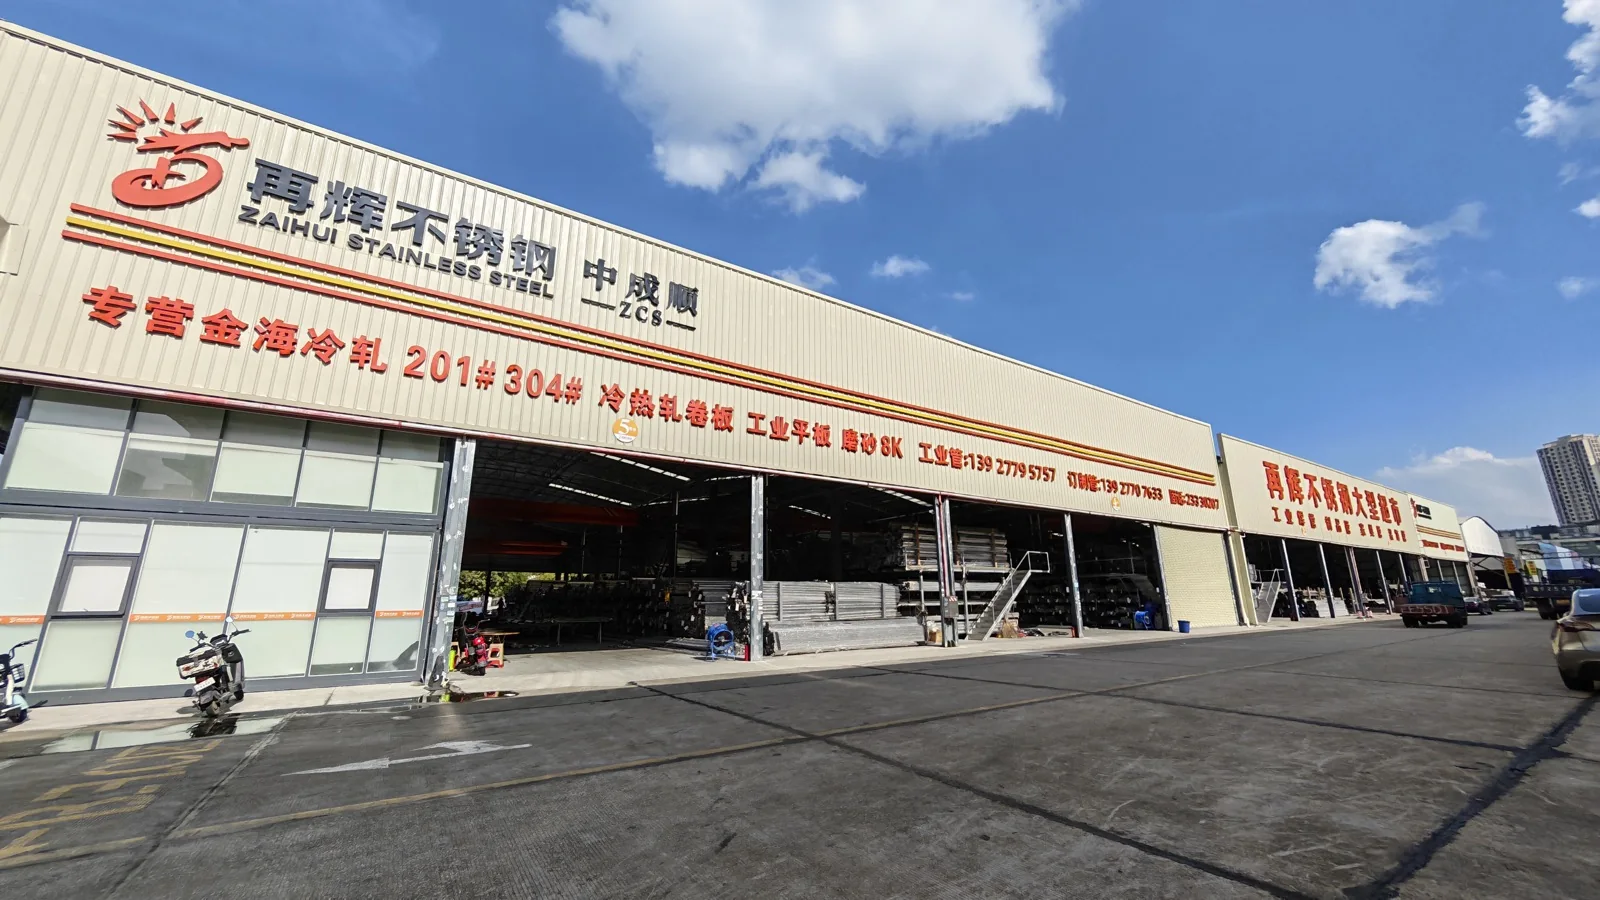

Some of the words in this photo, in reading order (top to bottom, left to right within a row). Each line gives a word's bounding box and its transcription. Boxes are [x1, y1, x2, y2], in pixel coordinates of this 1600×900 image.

[238, 205, 338, 243] ZAIHUI
[348, 233, 482, 280] STAINLESS
[489, 270, 555, 299] STEEL
[247, 158, 556, 281] 再辉不锈钢
[583, 258, 699, 318] 中成顺
[619, 301, 662, 327] ZCS
[82, 285, 388, 373] 专营金海冷轧
[403, 345, 496, 390] 201#
[504, 364, 583, 405] 304#
[598, 383, 734, 433] 冷热轧卷板
[747, 411, 832, 448] 工业平板
[1262, 460, 1402, 526] 再辉不锈钢大型超市
